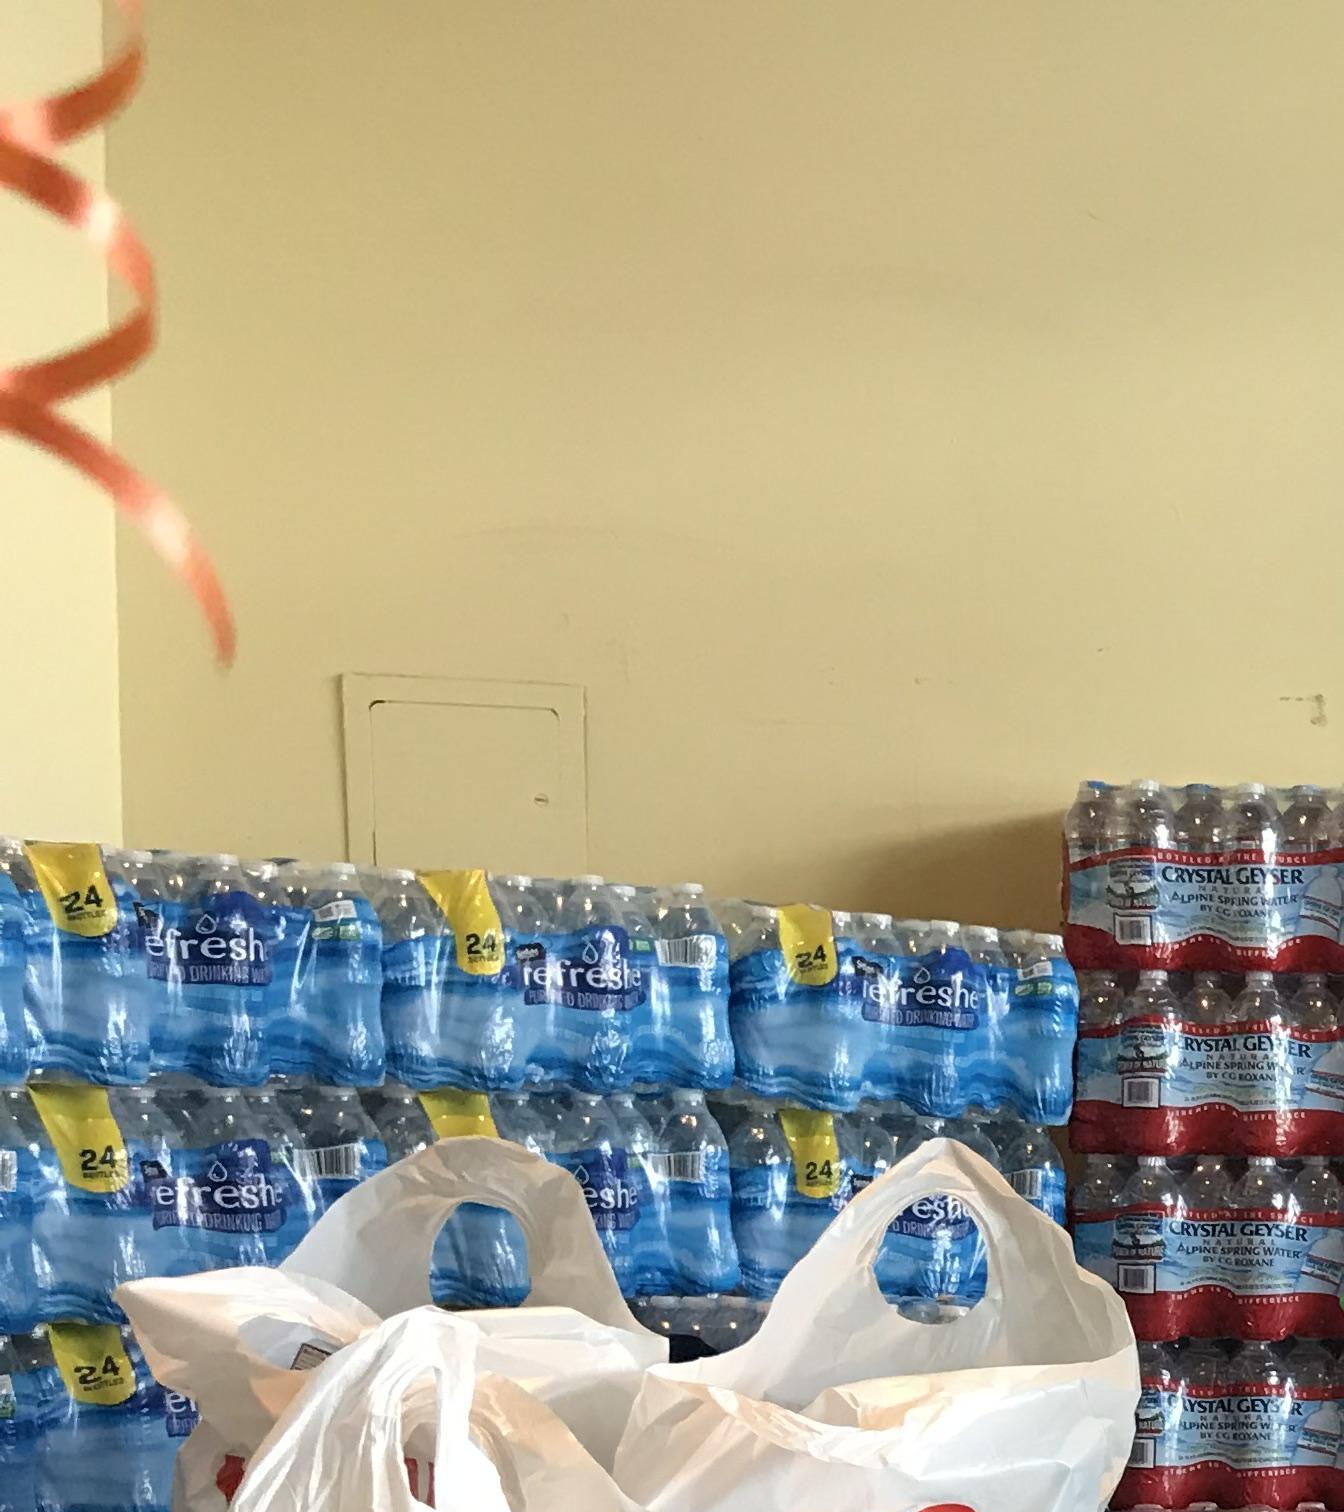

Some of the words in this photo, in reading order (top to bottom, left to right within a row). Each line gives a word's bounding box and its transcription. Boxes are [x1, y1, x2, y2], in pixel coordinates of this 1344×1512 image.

[1161, 866, 1233, 885] CRYSTAL
[60, 884, 104, 916] 24
[465, 931, 497, 956] 24
[794, 943, 828, 969] 24
[79, 1144, 119, 1172] 24
[805, 1160, 834, 1182] 24
[1168, 1222, 1238, 1239] CRYSTAL
[1240, 1223, 1308, 1242] GEYSER
[1219, 1245, 1260, 1258] SPRING
[1263, 1247, 1303, 1260] WATER
[74, 1355, 121, 1385] 24
